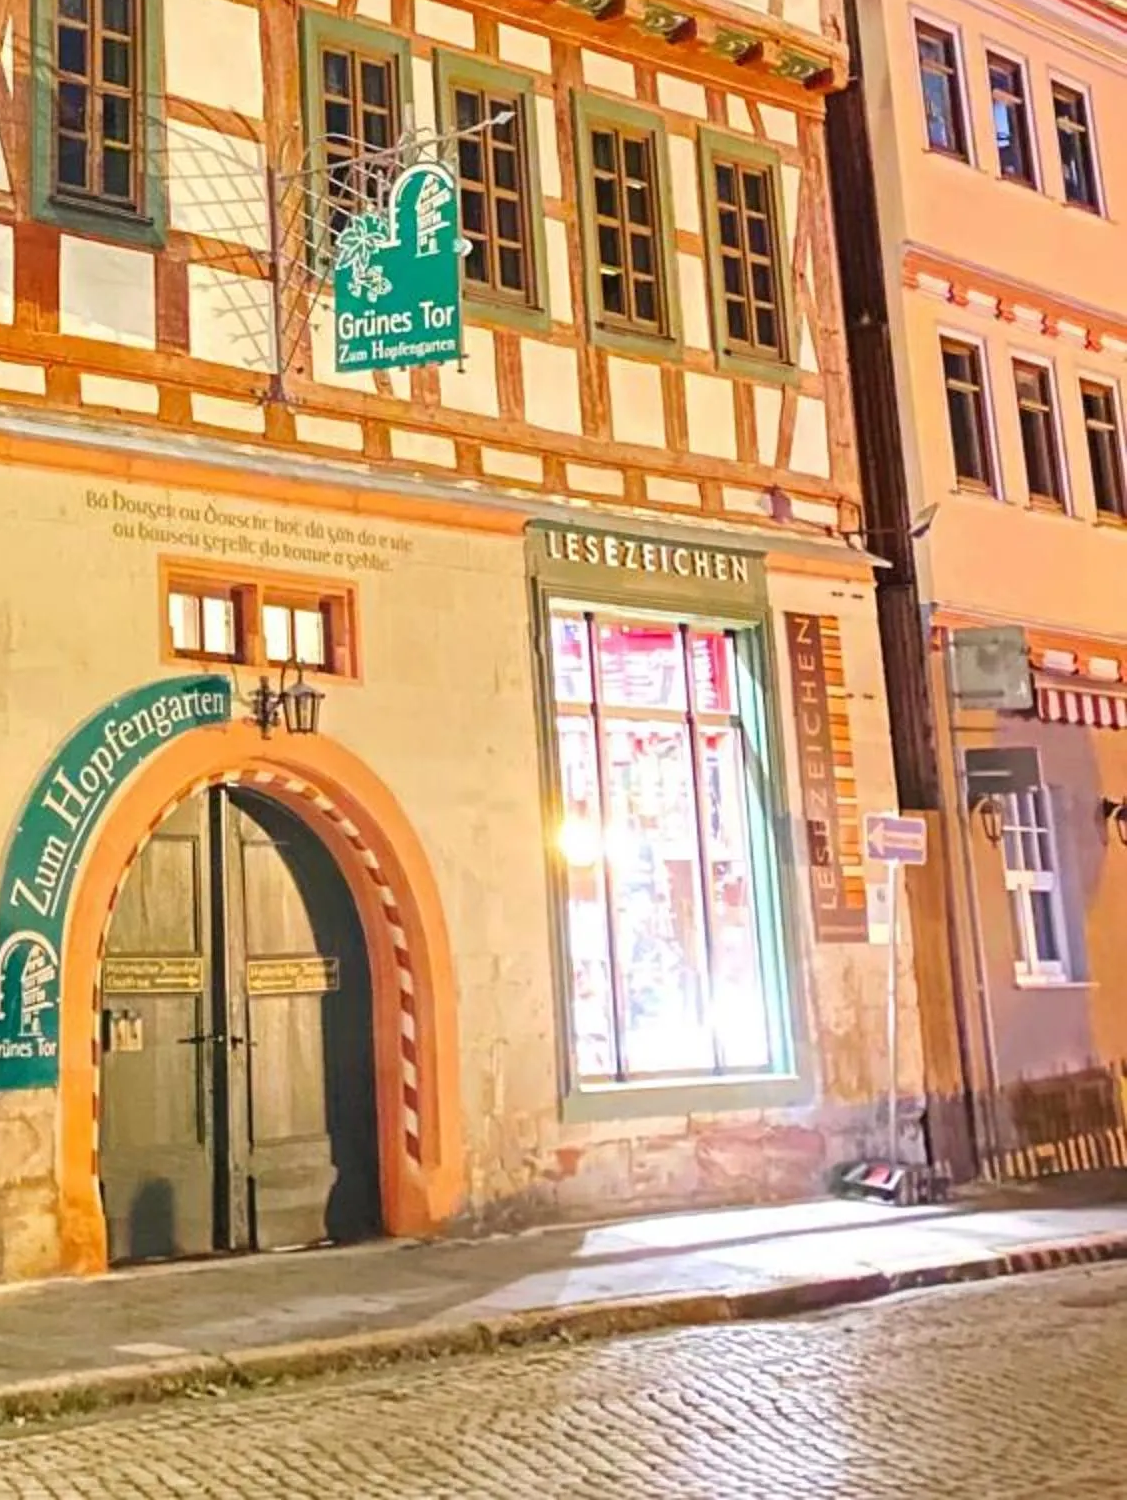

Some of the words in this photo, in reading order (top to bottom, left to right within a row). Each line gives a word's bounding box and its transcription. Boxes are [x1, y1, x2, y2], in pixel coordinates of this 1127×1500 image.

[338, 310, 412, 340] Grünes
[419, 301, 455, 329] Tor
[339, 344, 368, 364] Zum
[372, 340, 455, 361] Hopfengarten
[545, 531, 749, 583] LESEZEICHEN
[794, 617, 838, 910] LESEZEICHEN
[10, 834, 69, 916] Zum
[41, 688, 225, 833] Hopfengarten
[36, 1037, 57, 1056] Tor
